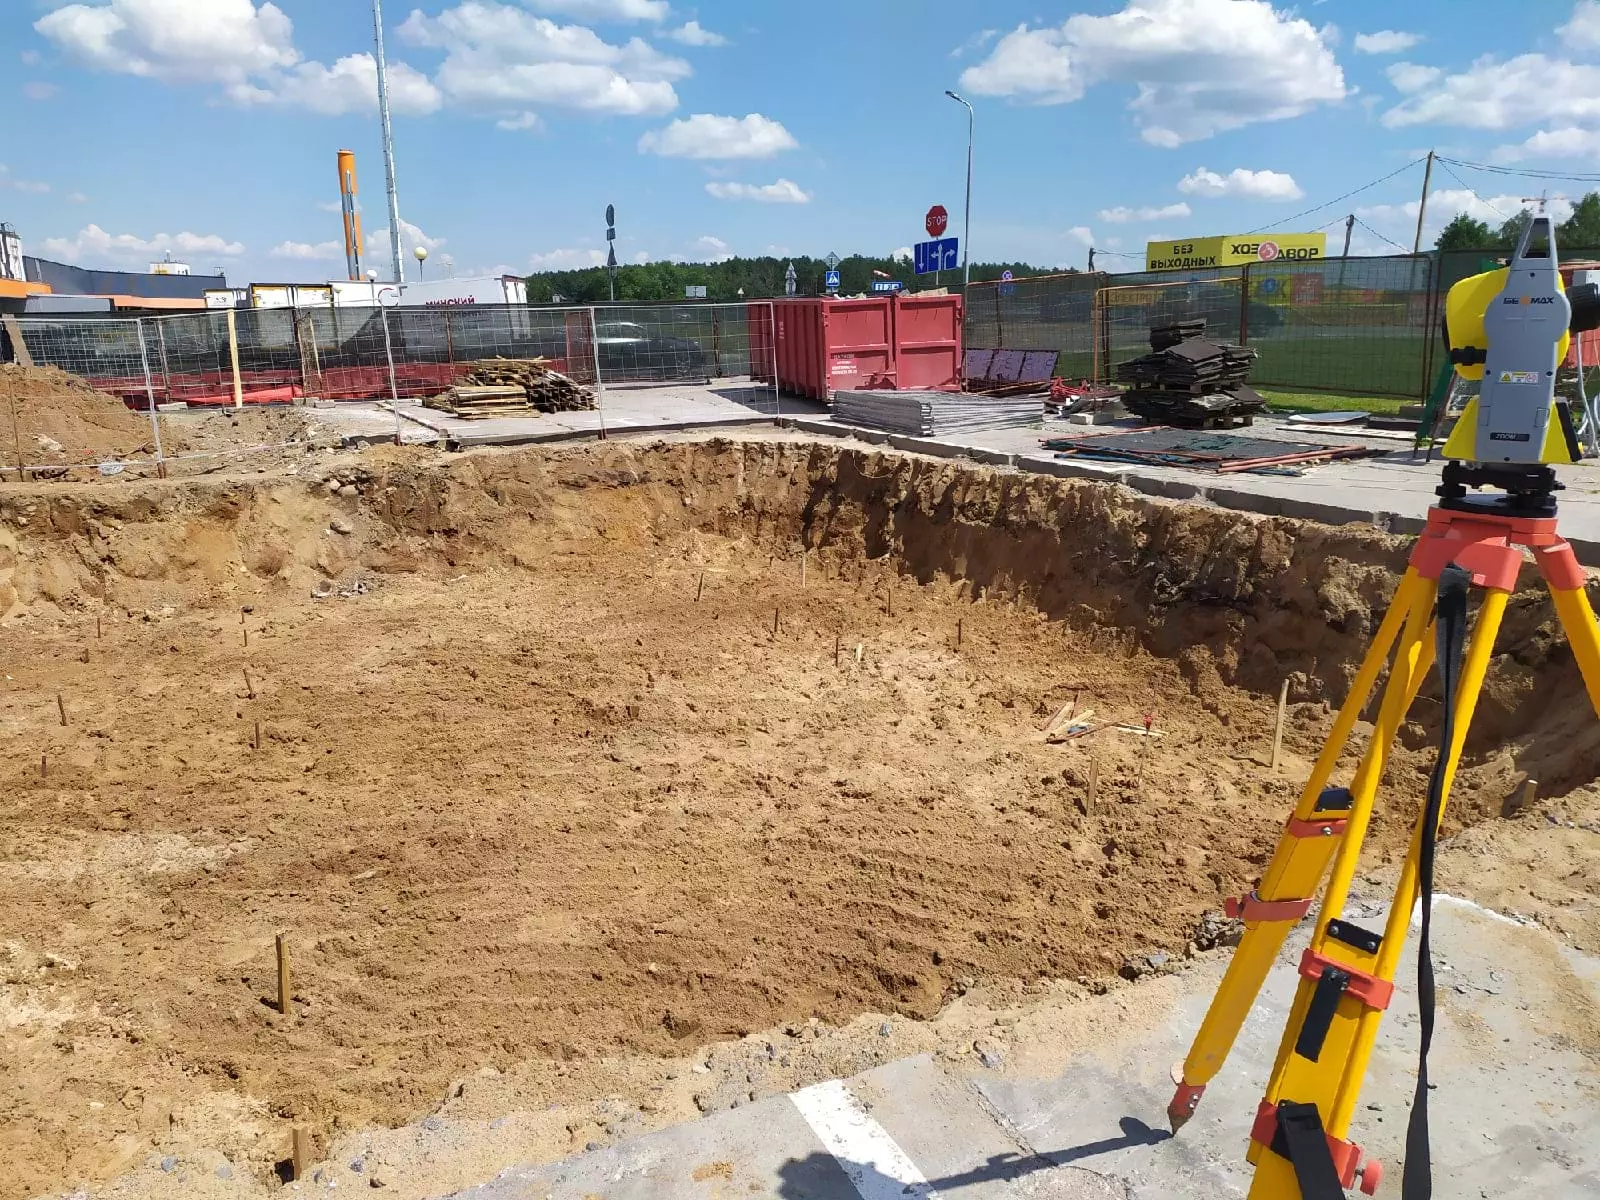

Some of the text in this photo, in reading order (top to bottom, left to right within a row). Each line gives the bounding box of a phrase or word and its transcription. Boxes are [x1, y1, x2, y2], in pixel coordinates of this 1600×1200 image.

[927, 215, 947, 227] STOP
[1173, 244, 1194, 255] БЕЗ
[1231, 243, 1260, 255] ХОЗ
[1150, 255, 1216, 271] ВЫХОДНЫХ
[425, 294, 475, 307] МИНСКИЙ
